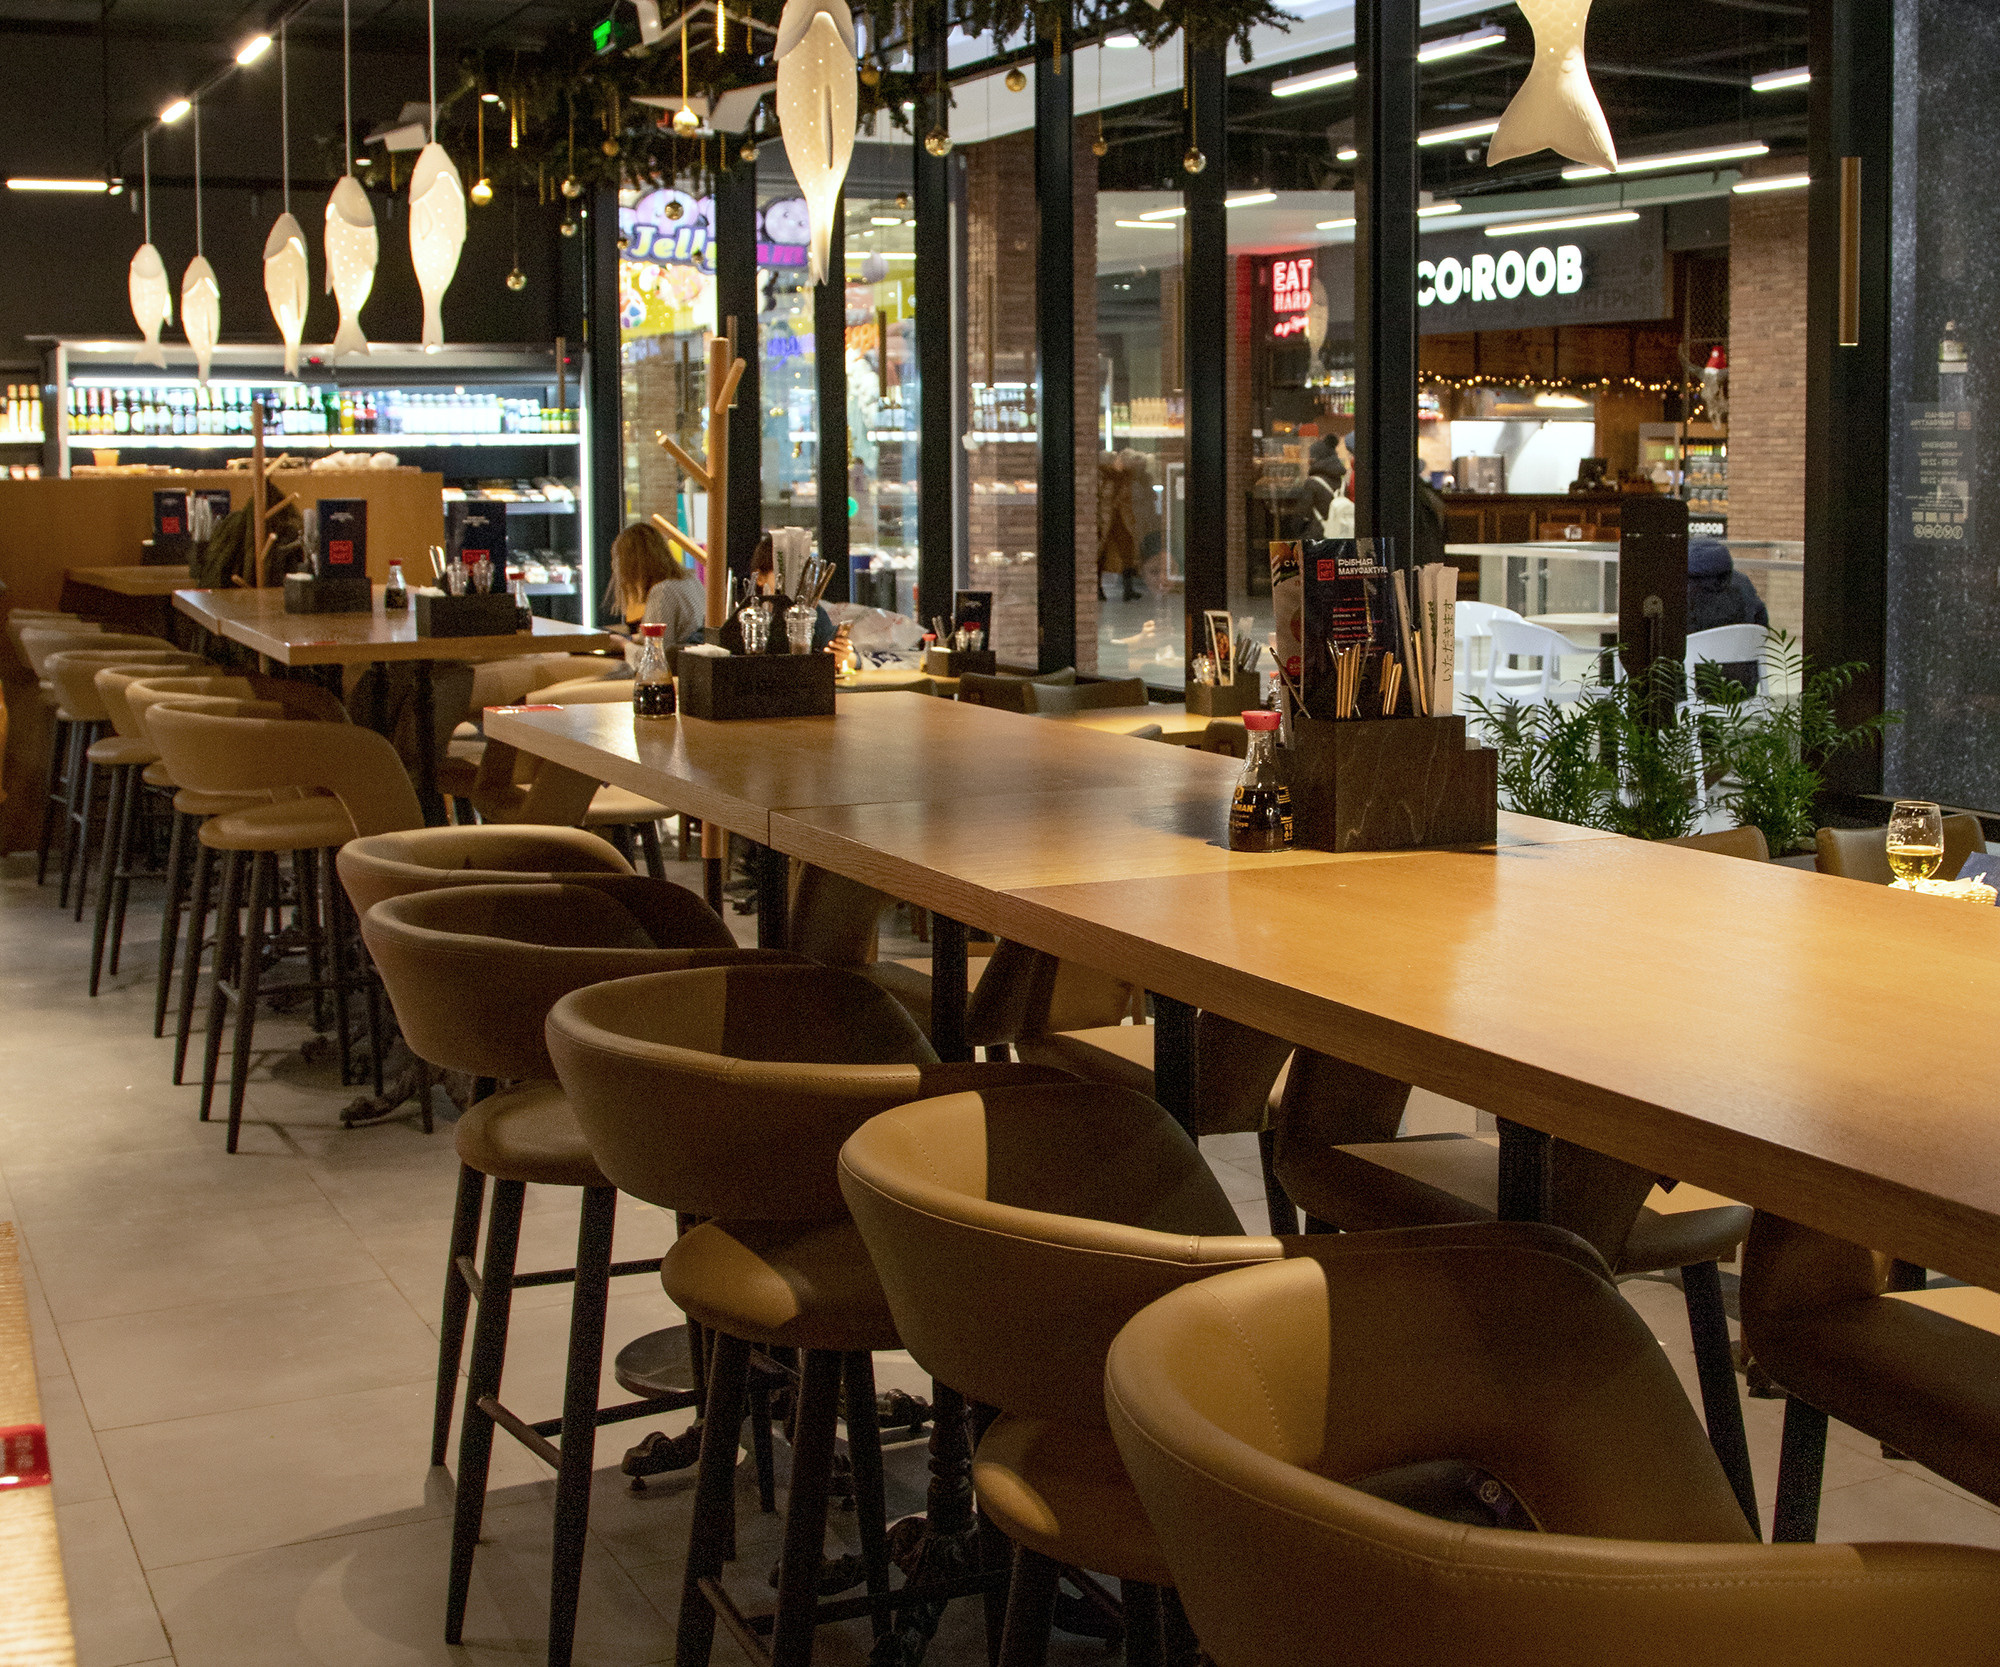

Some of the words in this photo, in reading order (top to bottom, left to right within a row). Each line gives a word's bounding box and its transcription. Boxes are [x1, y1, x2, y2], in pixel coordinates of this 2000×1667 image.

[1273, 258, 1313, 292] EAT
[1273, 290, 1312, 313] HARD
[1338, 557, 1373, 566] РЫБНАЯ
[1338, 566, 1388, 575] МАНУФАКТУРА
[1442, 599, 1454, 682] いただきます
